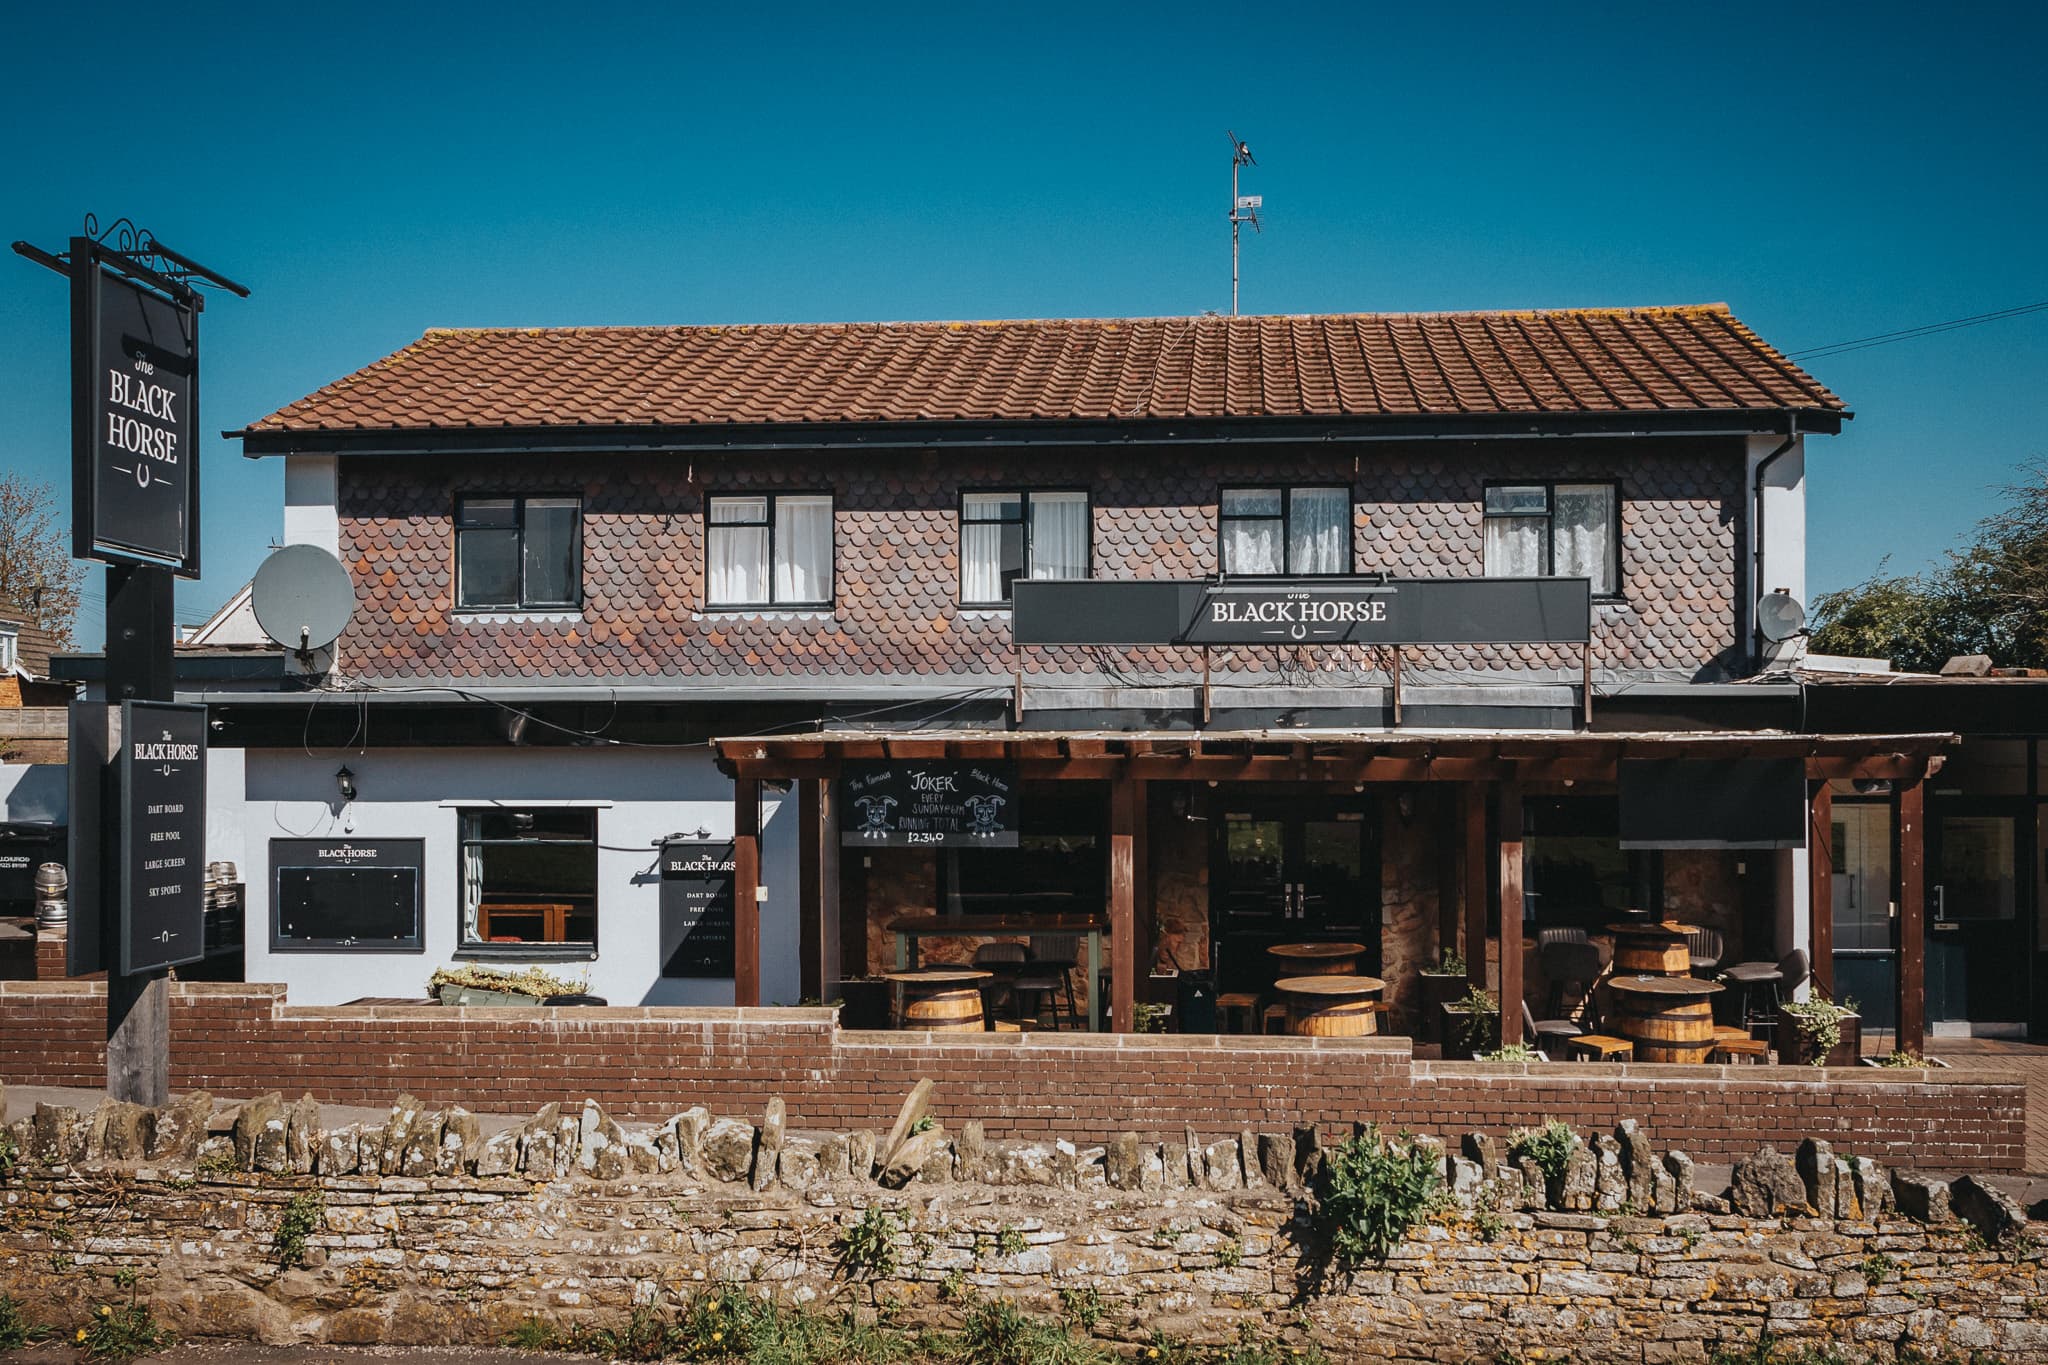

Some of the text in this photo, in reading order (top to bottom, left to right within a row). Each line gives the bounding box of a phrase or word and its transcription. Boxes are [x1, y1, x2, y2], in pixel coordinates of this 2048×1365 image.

[135, 351, 154, 376] The
[109, 368, 177, 423] BLACK
[107, 412, 178, 464] HORSE
[1212, 602, 1387, 623] BLACK HORSE
[134, 743, 199, 760] BLACK HORSE
[921, 793, 944, 804] EVERY
[148, 804, 184, 815] DART BOARD
[150, 831, 181, 842] FREE POOL
[318, 849, 377, 858] BLACK HORSE
[144, 857, 186, 870] LARGE SCREEN
[671, 861, 736, 871] BLACK HORS
[149, 885, 181, 897] SKY SPORTS
